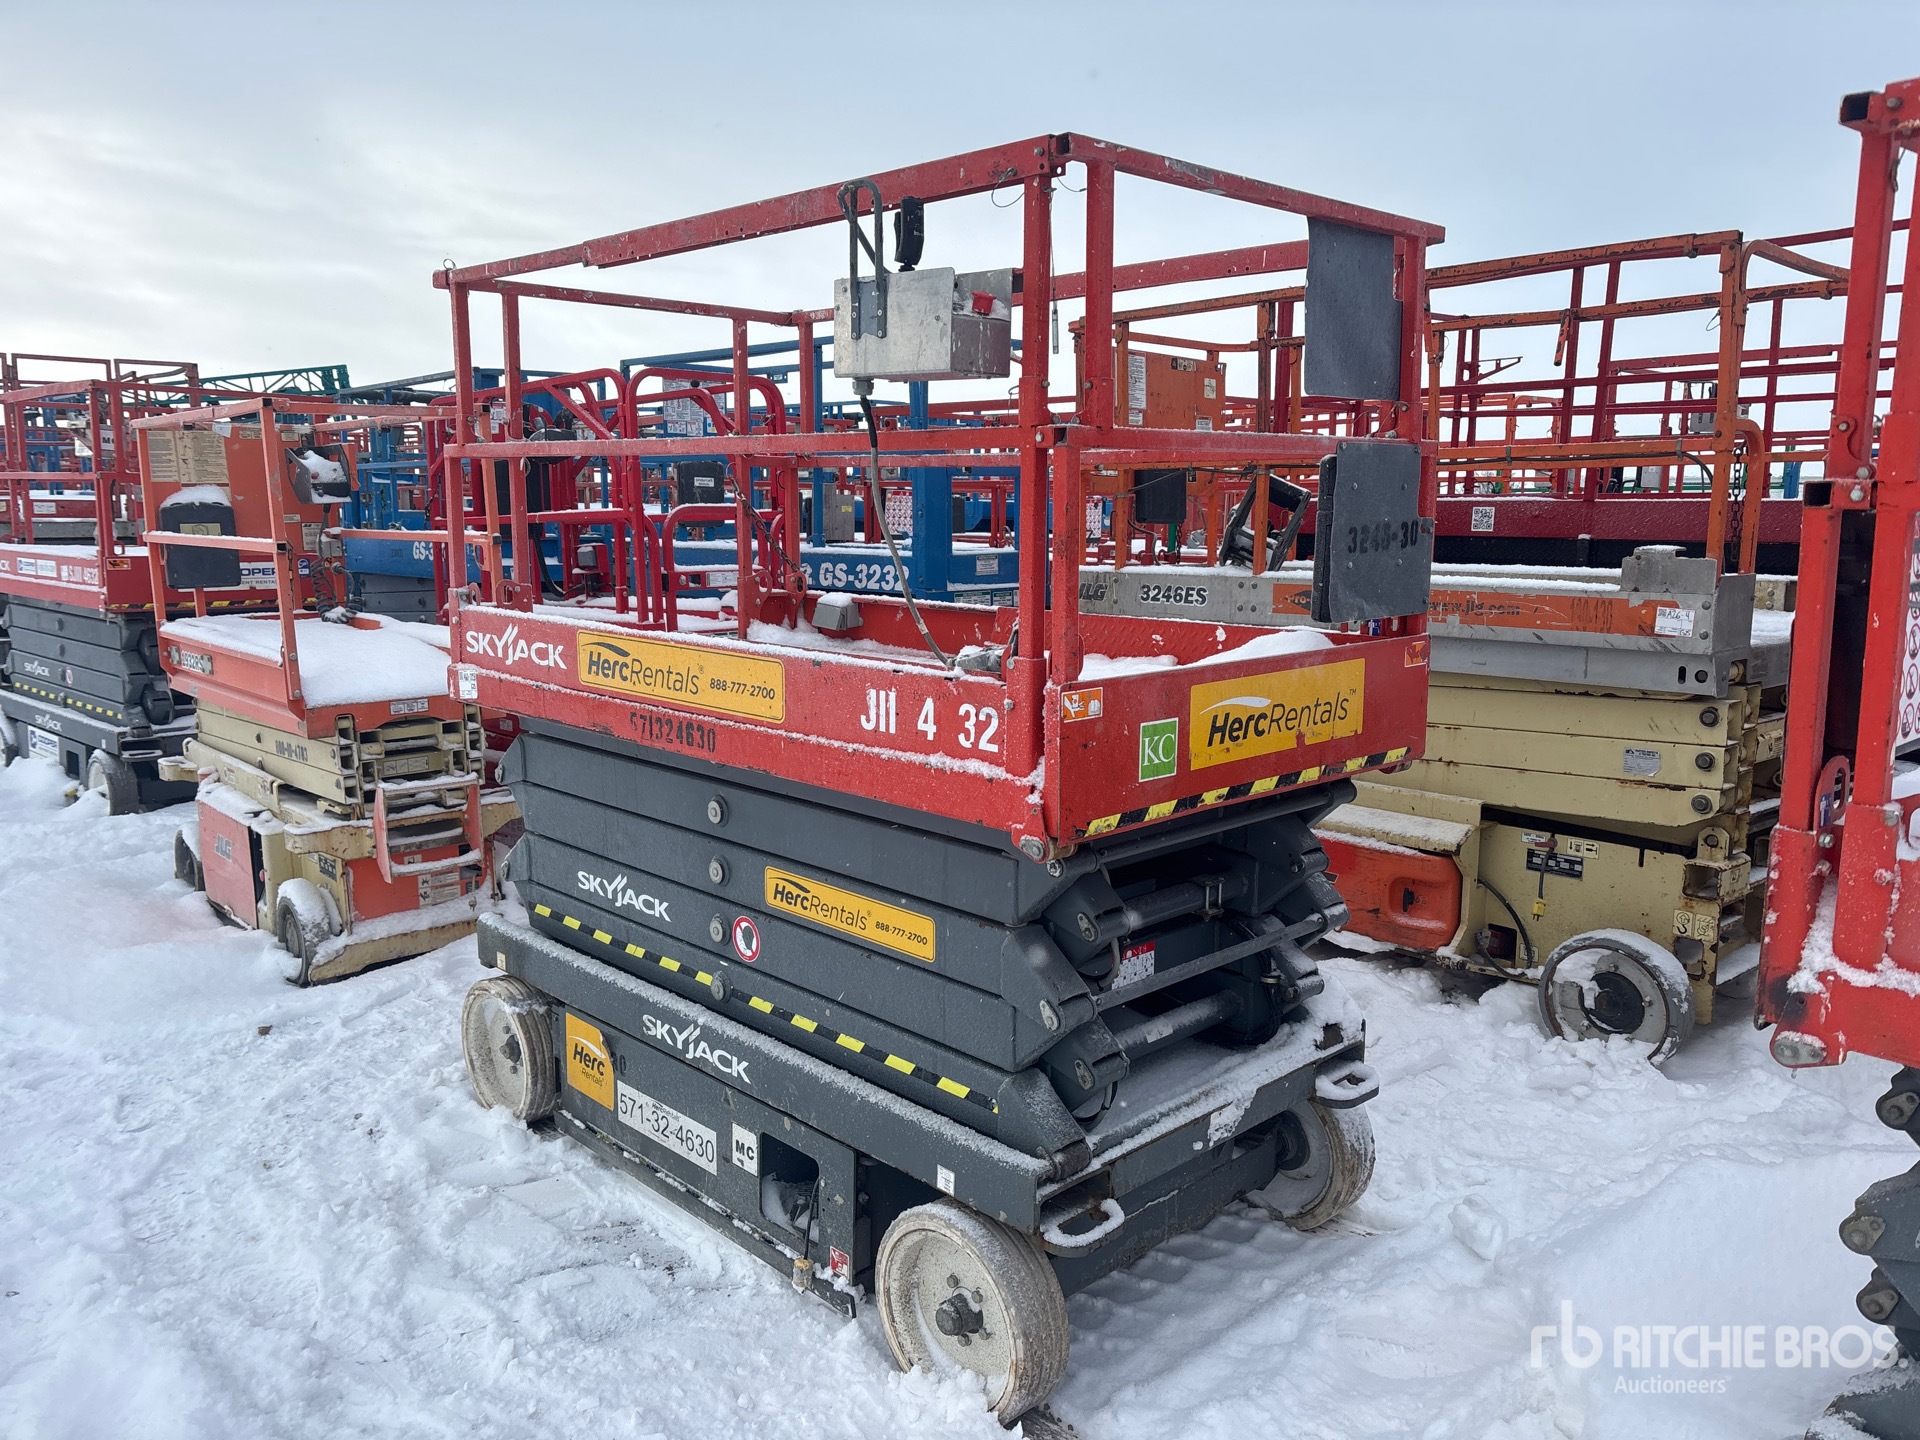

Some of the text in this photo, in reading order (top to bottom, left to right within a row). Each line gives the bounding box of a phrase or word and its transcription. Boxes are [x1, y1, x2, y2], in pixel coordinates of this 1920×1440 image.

[1140, 584, 1208, 607] 3246ES
[465, 623, 568, 670] SKYJACK
[709, 677, 776, 701] 888-777-2700
[629, 711, 717, 753] 571324630
[916, 697, 937, 741] 4
[957, 702, 999, 754] 32
[1142, 733, 1176, 767] KC
[215, 833, 232, 862] JLG
[576, 870, 672, 923] SKYJACK
[875, 920, 928, 946] 888-777-2700
[572, 1042, 606, 1077] Herc
[642, 1014, 752, 1085] SKYJACK
[581, 1068, 604, 1087] Rentals
[619, 1092, 715, 1164] 571-32-4630
[735, 1139, 755, 1161] MC
